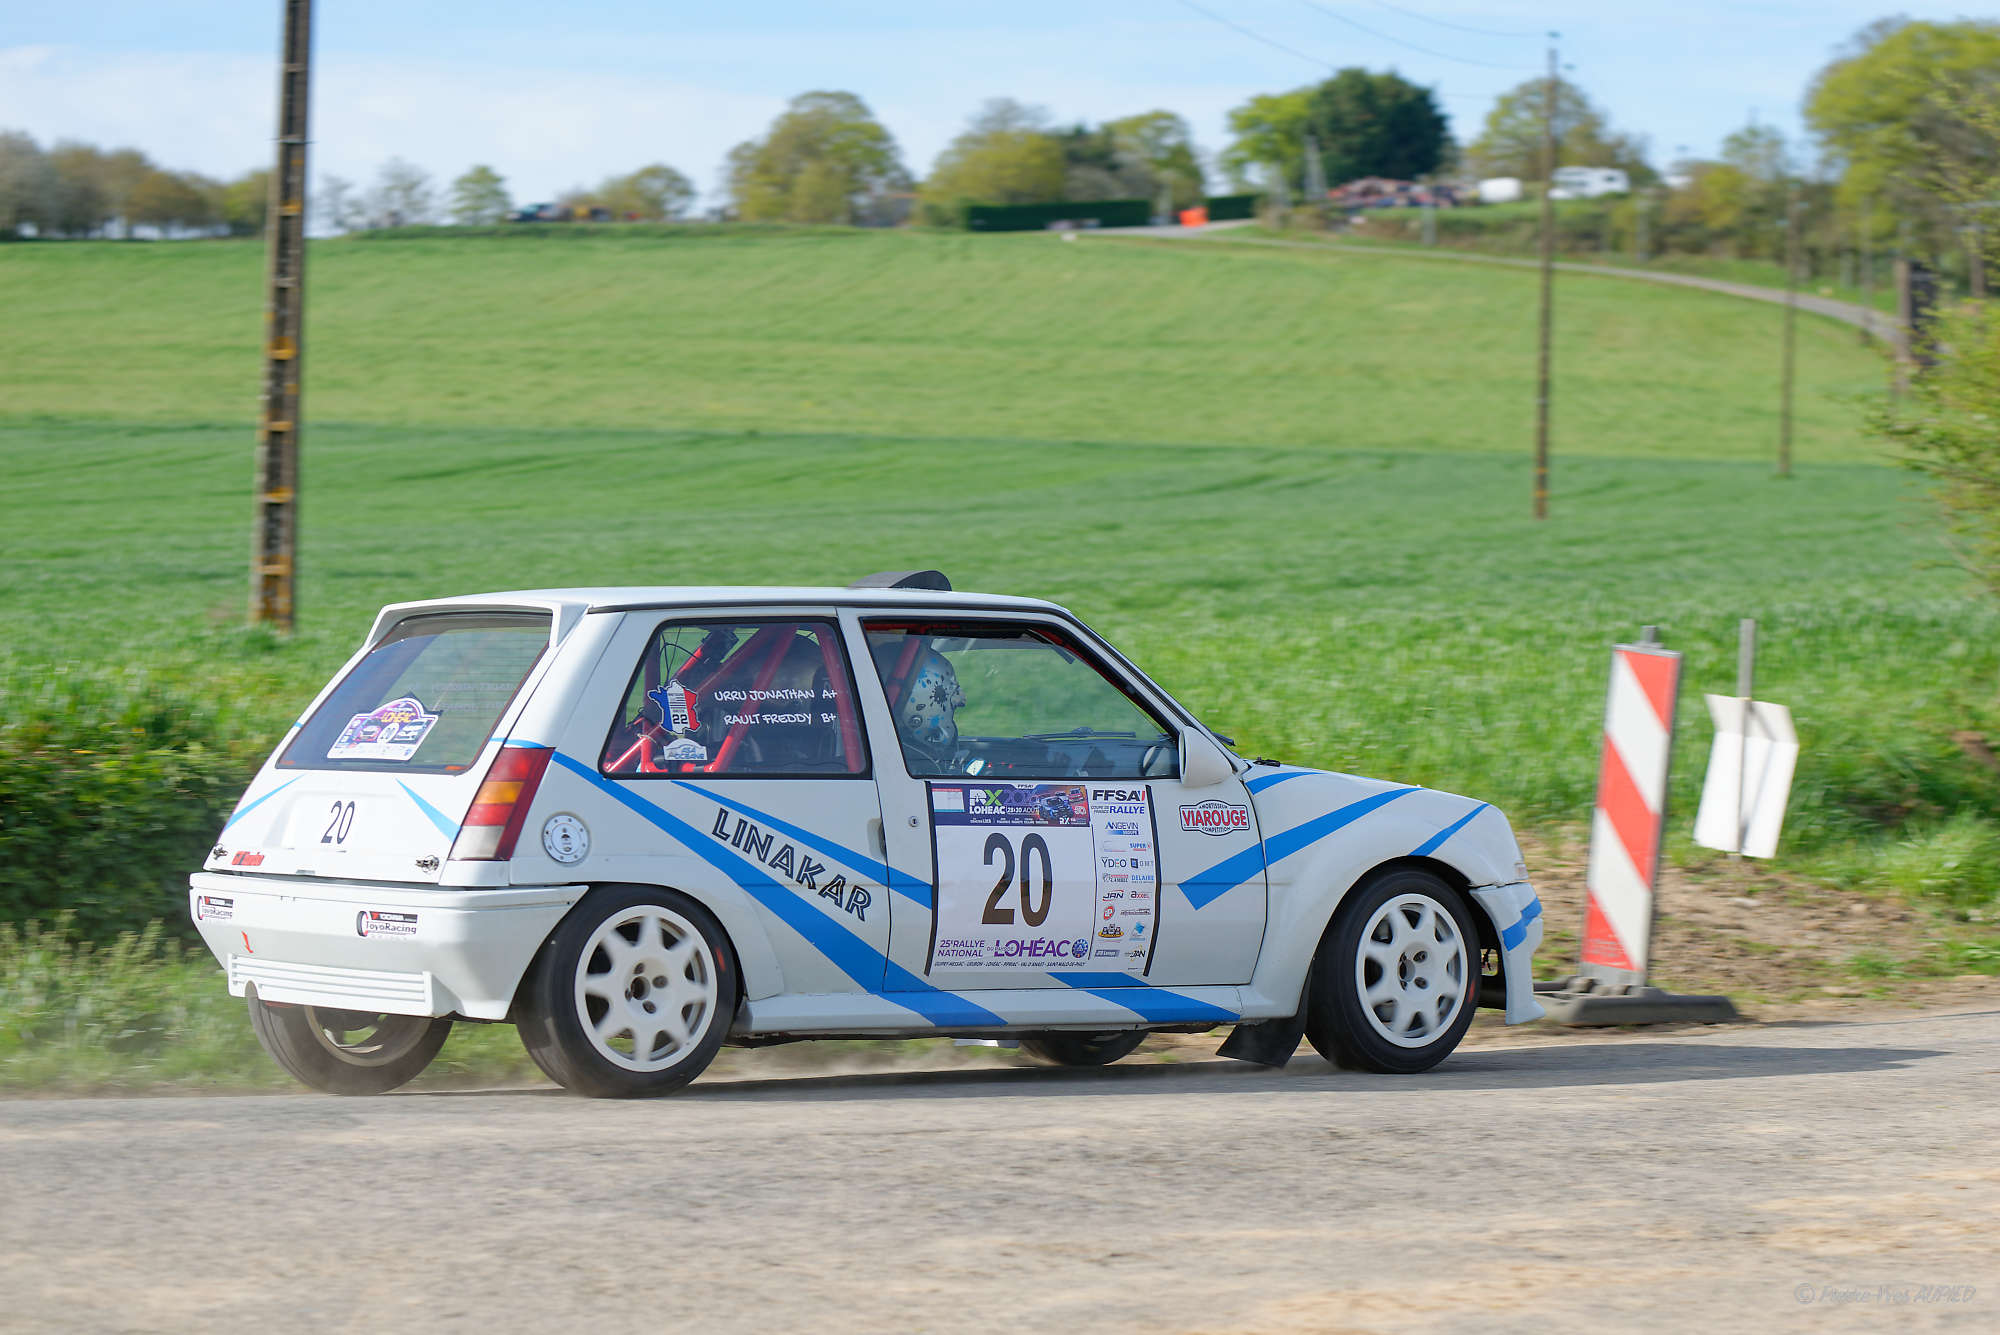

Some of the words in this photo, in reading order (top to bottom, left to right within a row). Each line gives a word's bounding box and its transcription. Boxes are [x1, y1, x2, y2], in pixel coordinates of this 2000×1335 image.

[714, 690, 748, 701] URRU
[749, 688, 815, 701] JONATHAN
[822, 689, 838, 700] A+
[672, 714, 688, 724] 22
[723, 714, 760, 726] RAULT
[762, 713, 813, 725] FREDDY
[822, 713, 837, 723] B+
[1092, 789, 1141, 802] FFSA
[969, 806, 1006, 815] LOHEAC
[1109, 805, 1145, 815] RALLYE
[320, 800, 355, 844] 20
[1181, 809, 1248, 827] VIAROUGE
[1104, 821, 1139, 830] ANGEVIN
[711, 807, 872, 922] LINAKAR
[981, 832, 1053, 927] 20
[953, 939, 985, 949] RALLYE
[994, 937, 1071, 958] LOHÉAC
[937, 949, 983, 958] NATIONAL
